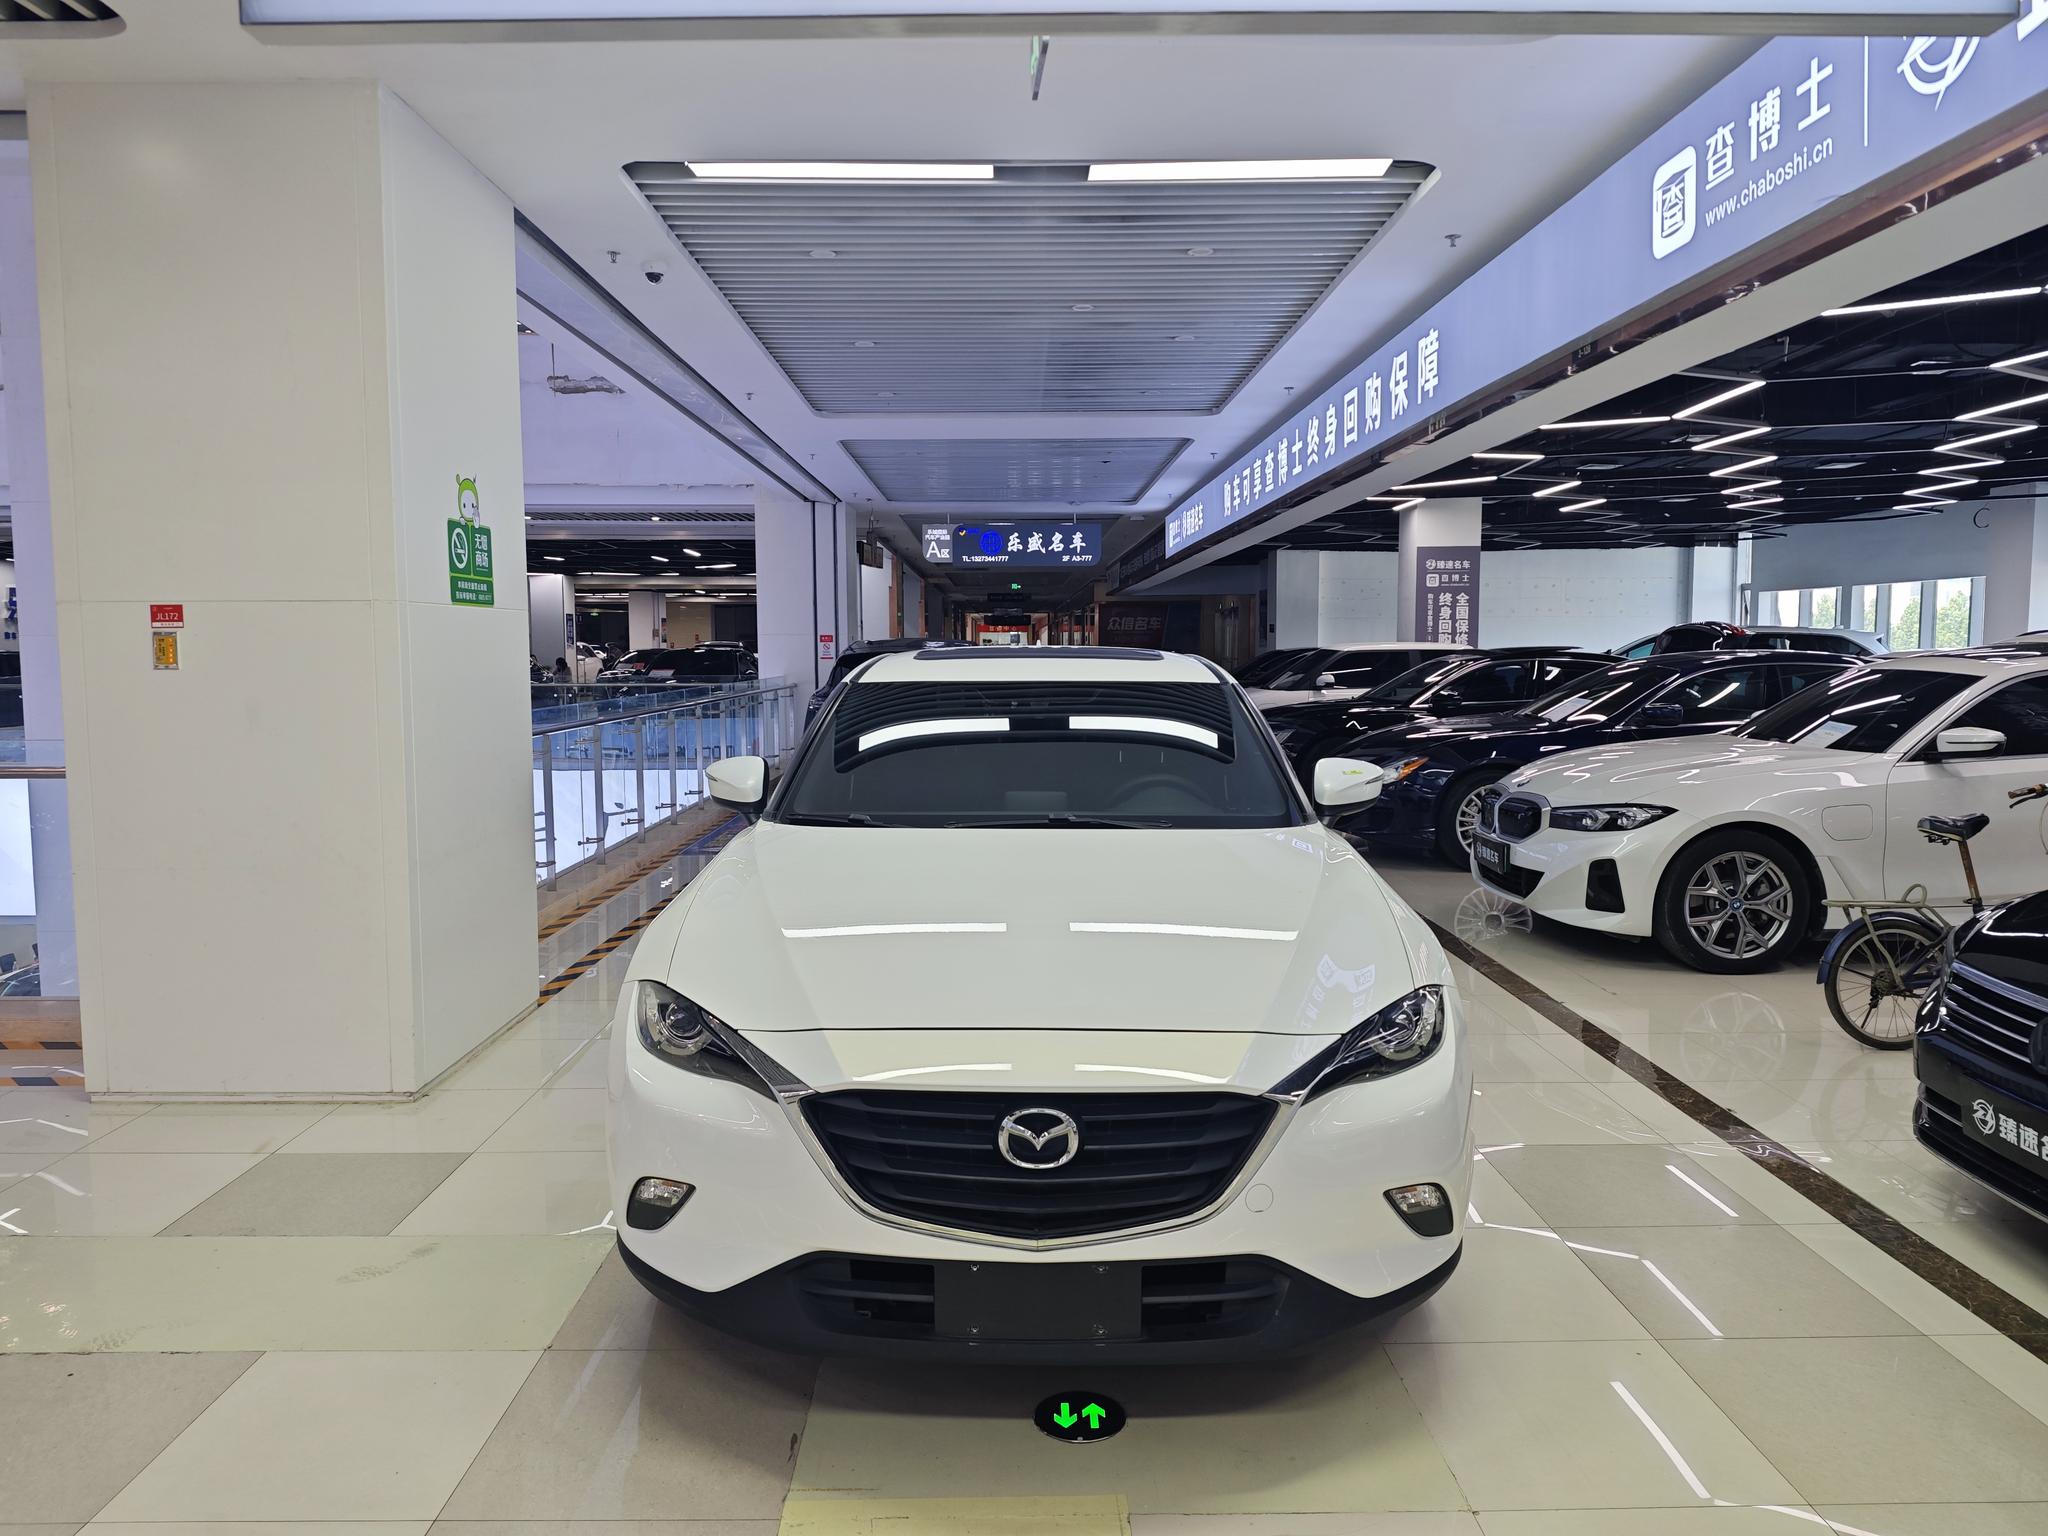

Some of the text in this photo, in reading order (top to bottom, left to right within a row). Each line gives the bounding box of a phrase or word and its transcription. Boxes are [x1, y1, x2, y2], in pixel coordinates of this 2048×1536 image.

[1704, 56, 1834, 192] 查博士
[1704, 136, 1834, 228] www.chaboshi.cn
[1223, 328, 1440, 517] 购车可享查博士终身回购保障
[1007, 531, 1087, 554] 乐盛名车
[156, 612, 179, 621] JL172
